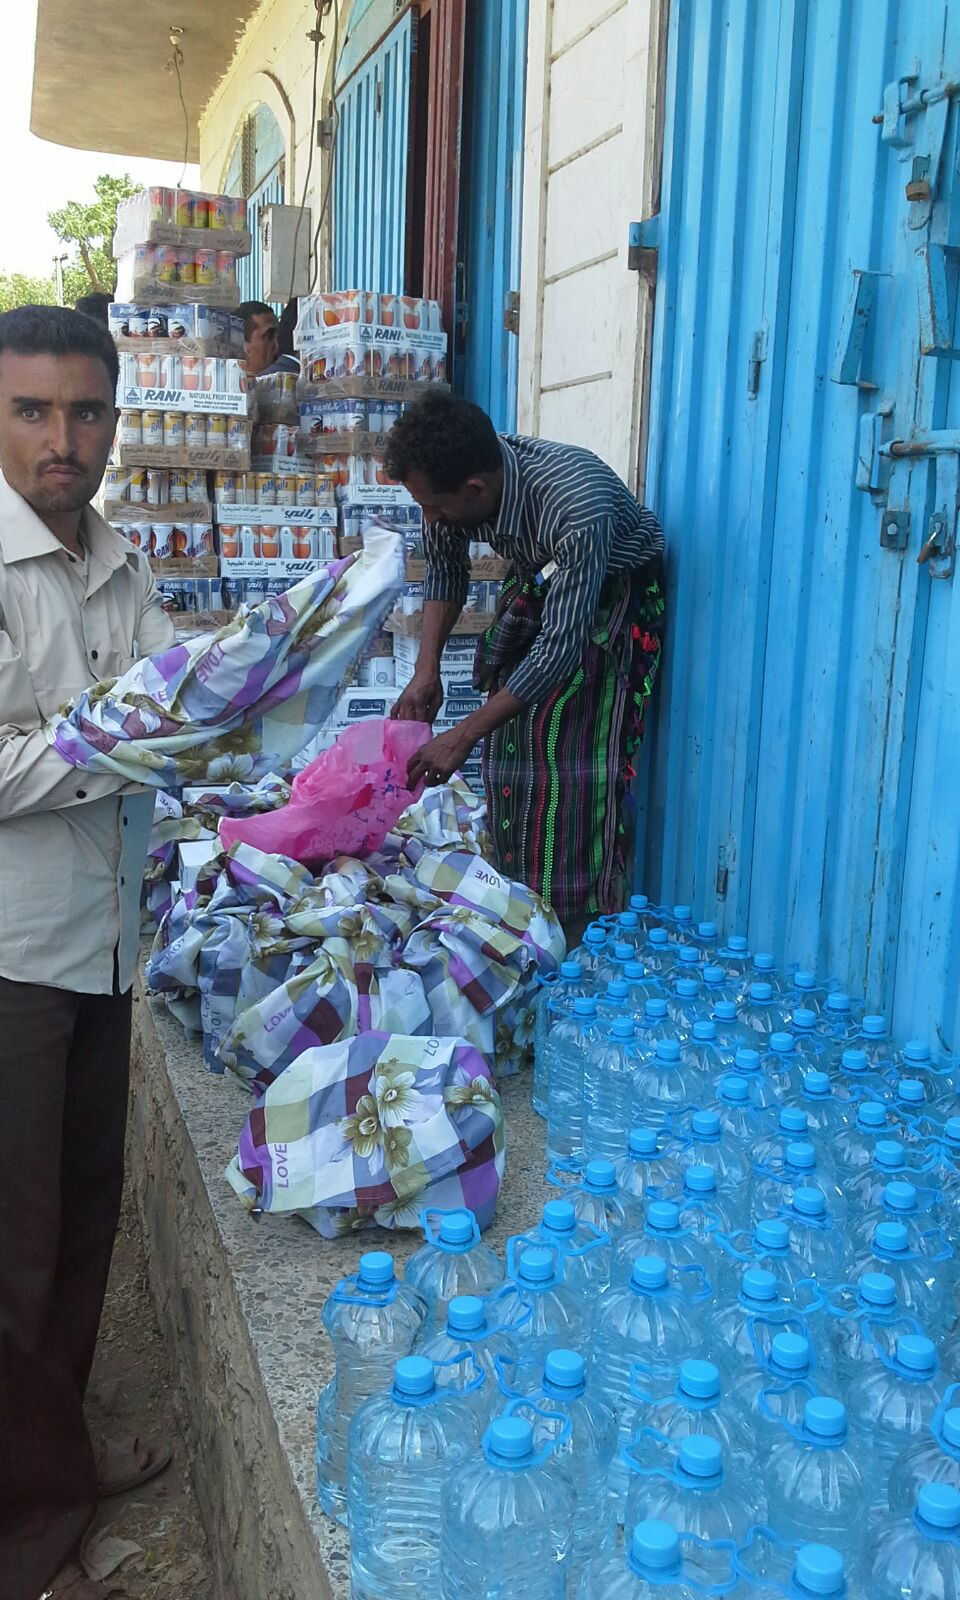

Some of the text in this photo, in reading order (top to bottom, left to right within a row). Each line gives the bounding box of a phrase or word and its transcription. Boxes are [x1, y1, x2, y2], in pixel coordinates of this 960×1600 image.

[374, 328, 401, 342] RANI
[144, 389, 182, 402] RANI
[377, 379, 406, 393] RANI
[189, 392, 211, 400] NATURAL
[213, 393, 227, 401] FRUIT
[448, 638, 478, 646] ALMANDA
[196, 642, 225, 683] LOVE
[475, 869, 501, 889] LOVE
[163, 938, 185, 966] LOVE
[211, 1010, 222, 1043] LOVE
[263, 1004, 293, 1033] LOV
[423, 1038, 440, 1057] LO
[274, 1143, 290, 1189] LOVE
